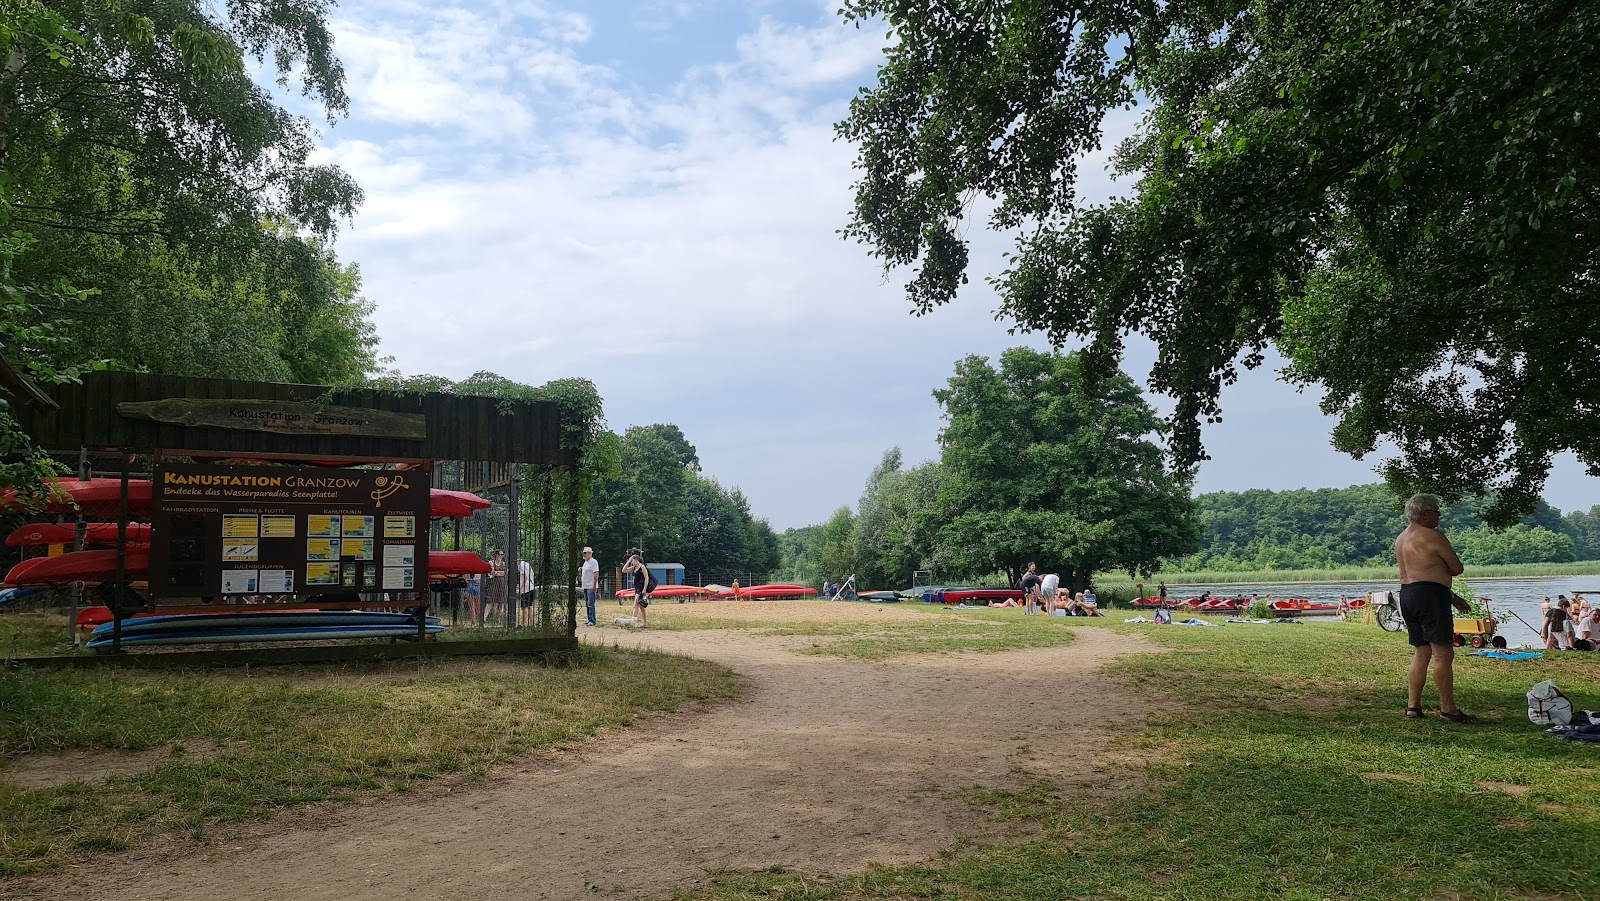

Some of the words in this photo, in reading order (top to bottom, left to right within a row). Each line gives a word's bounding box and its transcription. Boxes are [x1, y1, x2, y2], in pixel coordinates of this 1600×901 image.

[229, 407, 301, 422] Kanustation
[313, 413, 364, 426] Granzow
[164, 472, 281, 487] KANUSTATION
[285, 476, 360, 488] GRANZOW
[164, 487, 202, 495] Endecke
[205, 487, 221, 496] das
[223, 489, 290, 499] Wasserparadies
[292, 490, 338, 500] Seenplatte!
